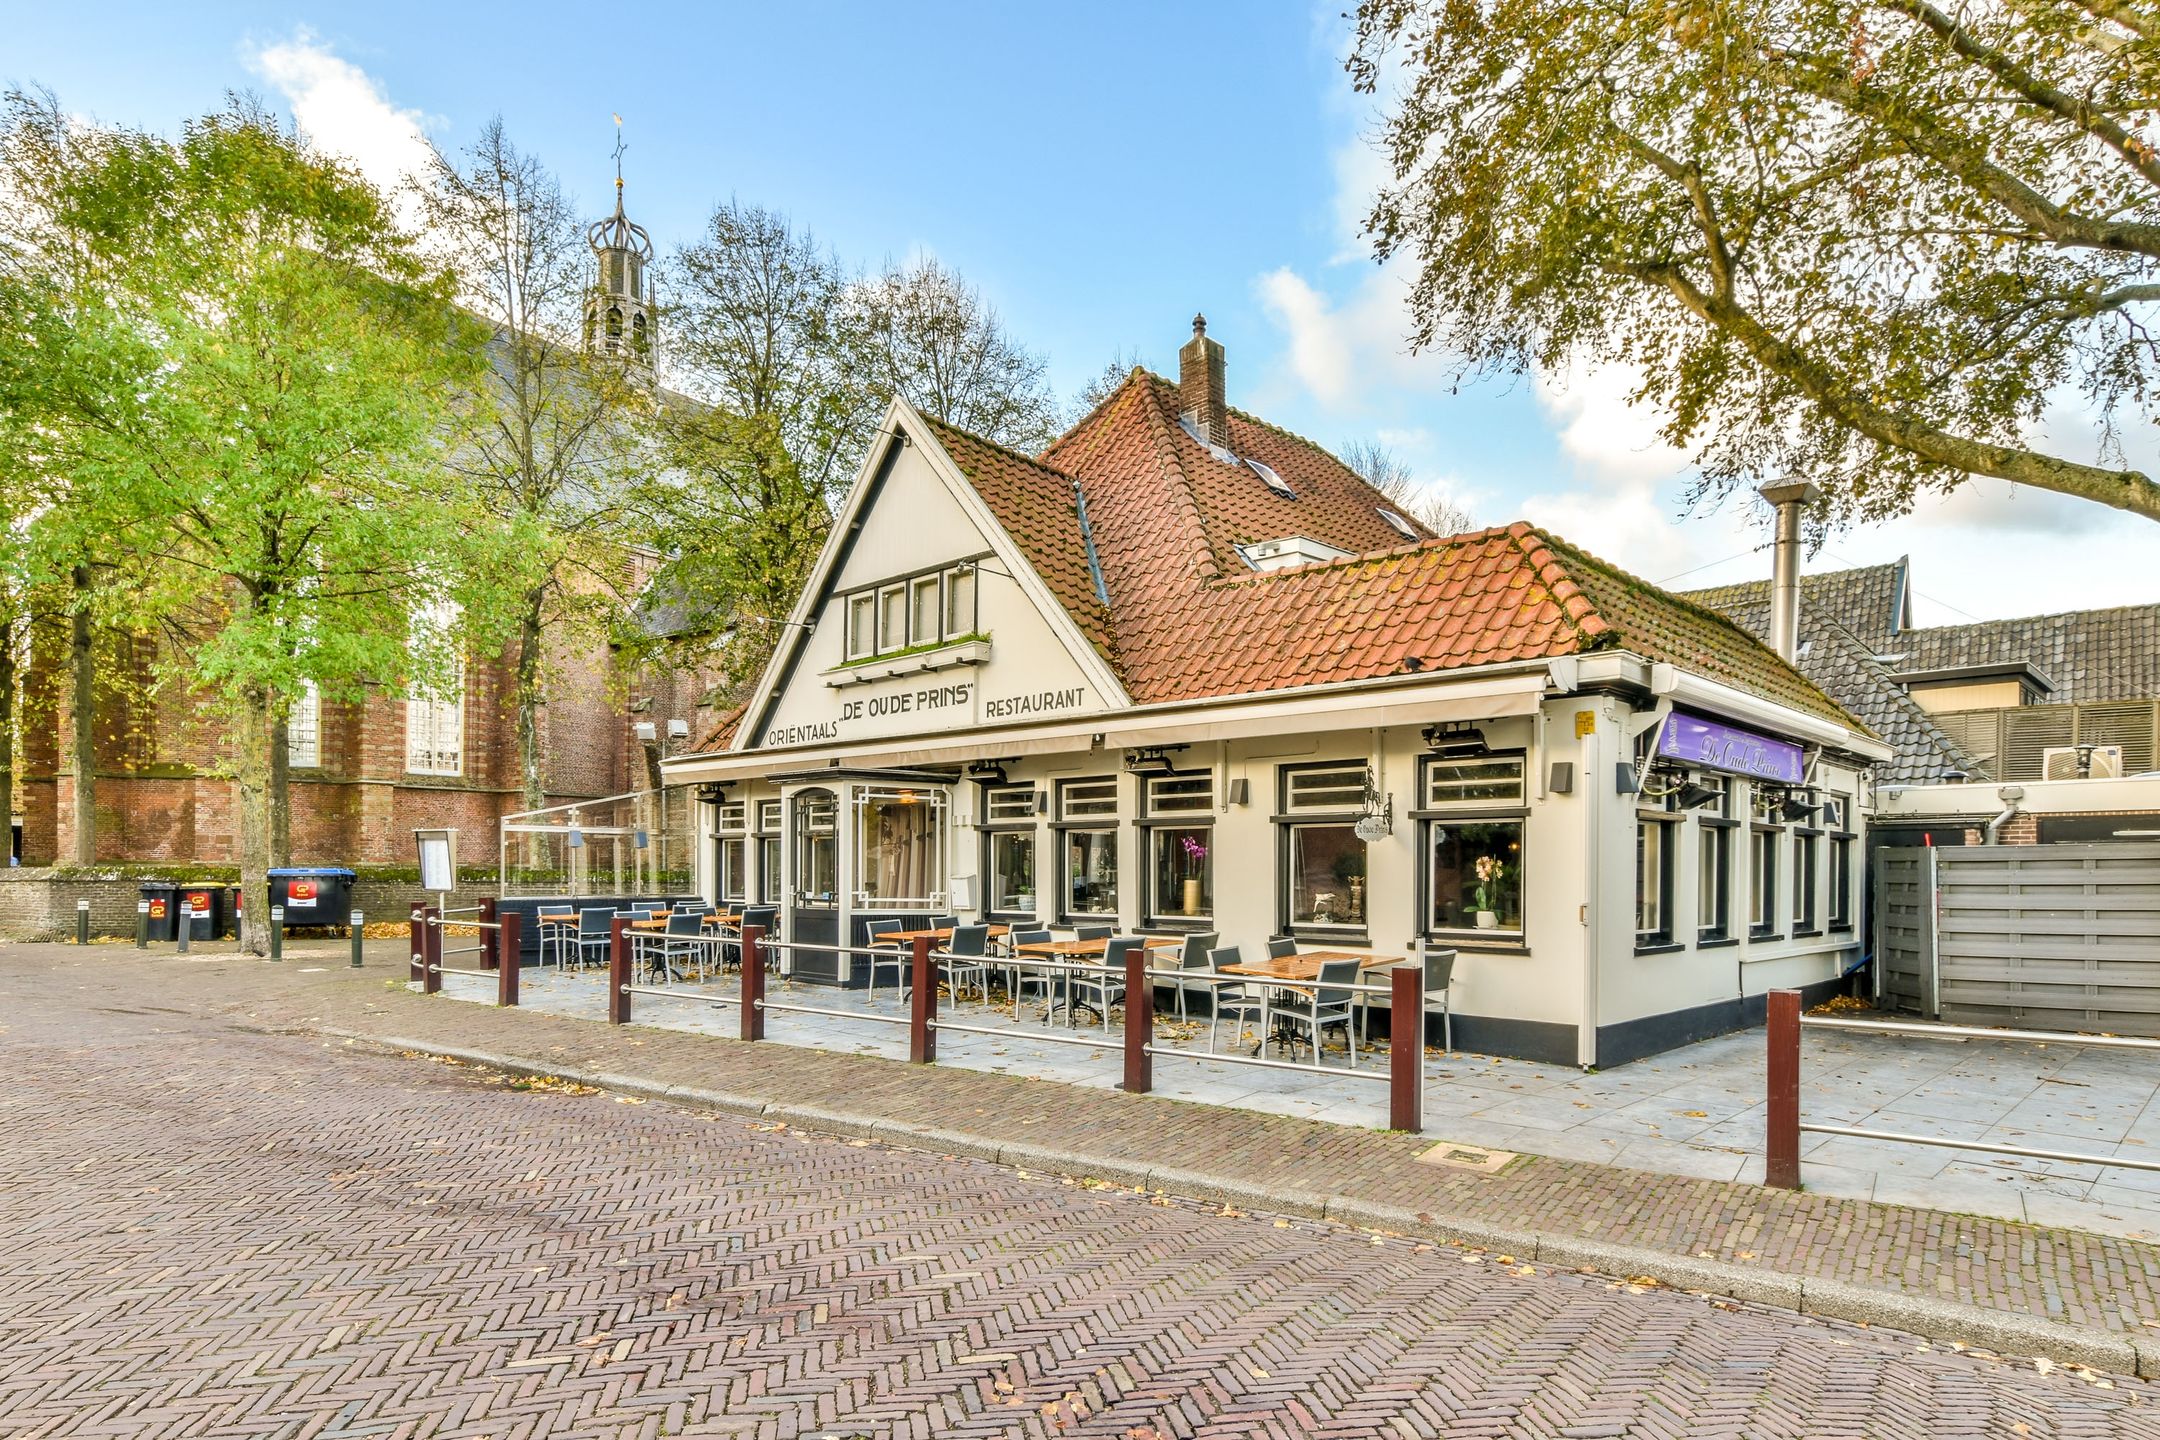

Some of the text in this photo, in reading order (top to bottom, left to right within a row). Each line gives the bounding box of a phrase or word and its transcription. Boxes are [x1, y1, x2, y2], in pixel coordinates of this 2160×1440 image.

[868, 692, 913, 717] OUDE
[986, 687, 1085, 718] RESTAURANT
[769, 720, 838, 746] ORIËNTAALS
[1699, 734, 1720, 763] De
[1722, 740, 1749, 770] Oude
[1751, 748, 1780, 776] Prins
